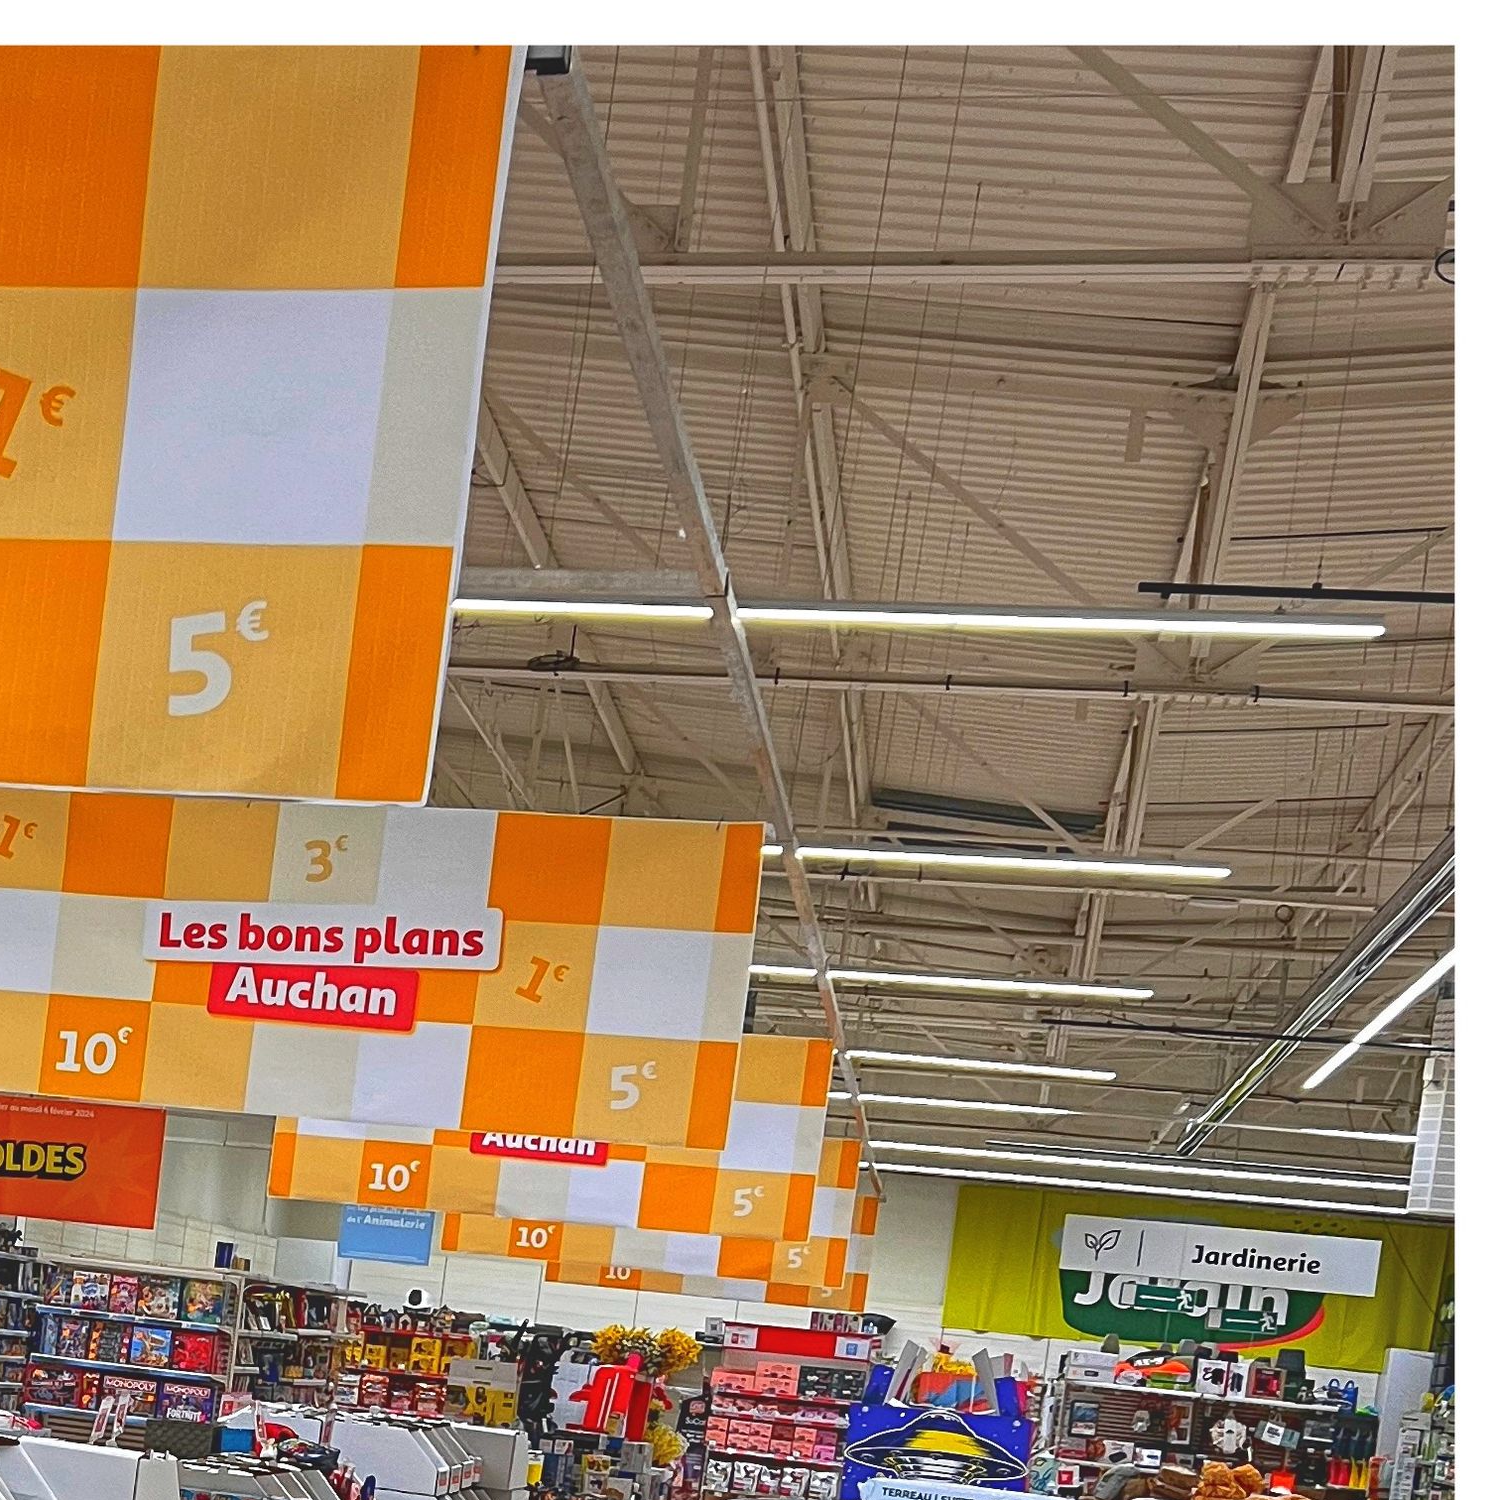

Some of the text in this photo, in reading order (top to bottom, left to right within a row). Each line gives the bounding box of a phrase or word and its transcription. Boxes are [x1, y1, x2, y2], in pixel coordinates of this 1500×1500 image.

[166, 598, 270, 718] 5€
[304, 835, 348, 883] 3€
[158, 910, 484, 963] Les bons plans
[224, 970, 397, 1017] Auchan
[515, 955, 570, 1004] 1€
[54, 1025, 133, 1077] 10€
[608, 1060, 658, 1111] 5€
[481, 1132, 596, 1157] Auchan
[1191, 1244, 1321, 1275] Jardinerie
[105, 1378, 155, 1391] MONOPOLY
